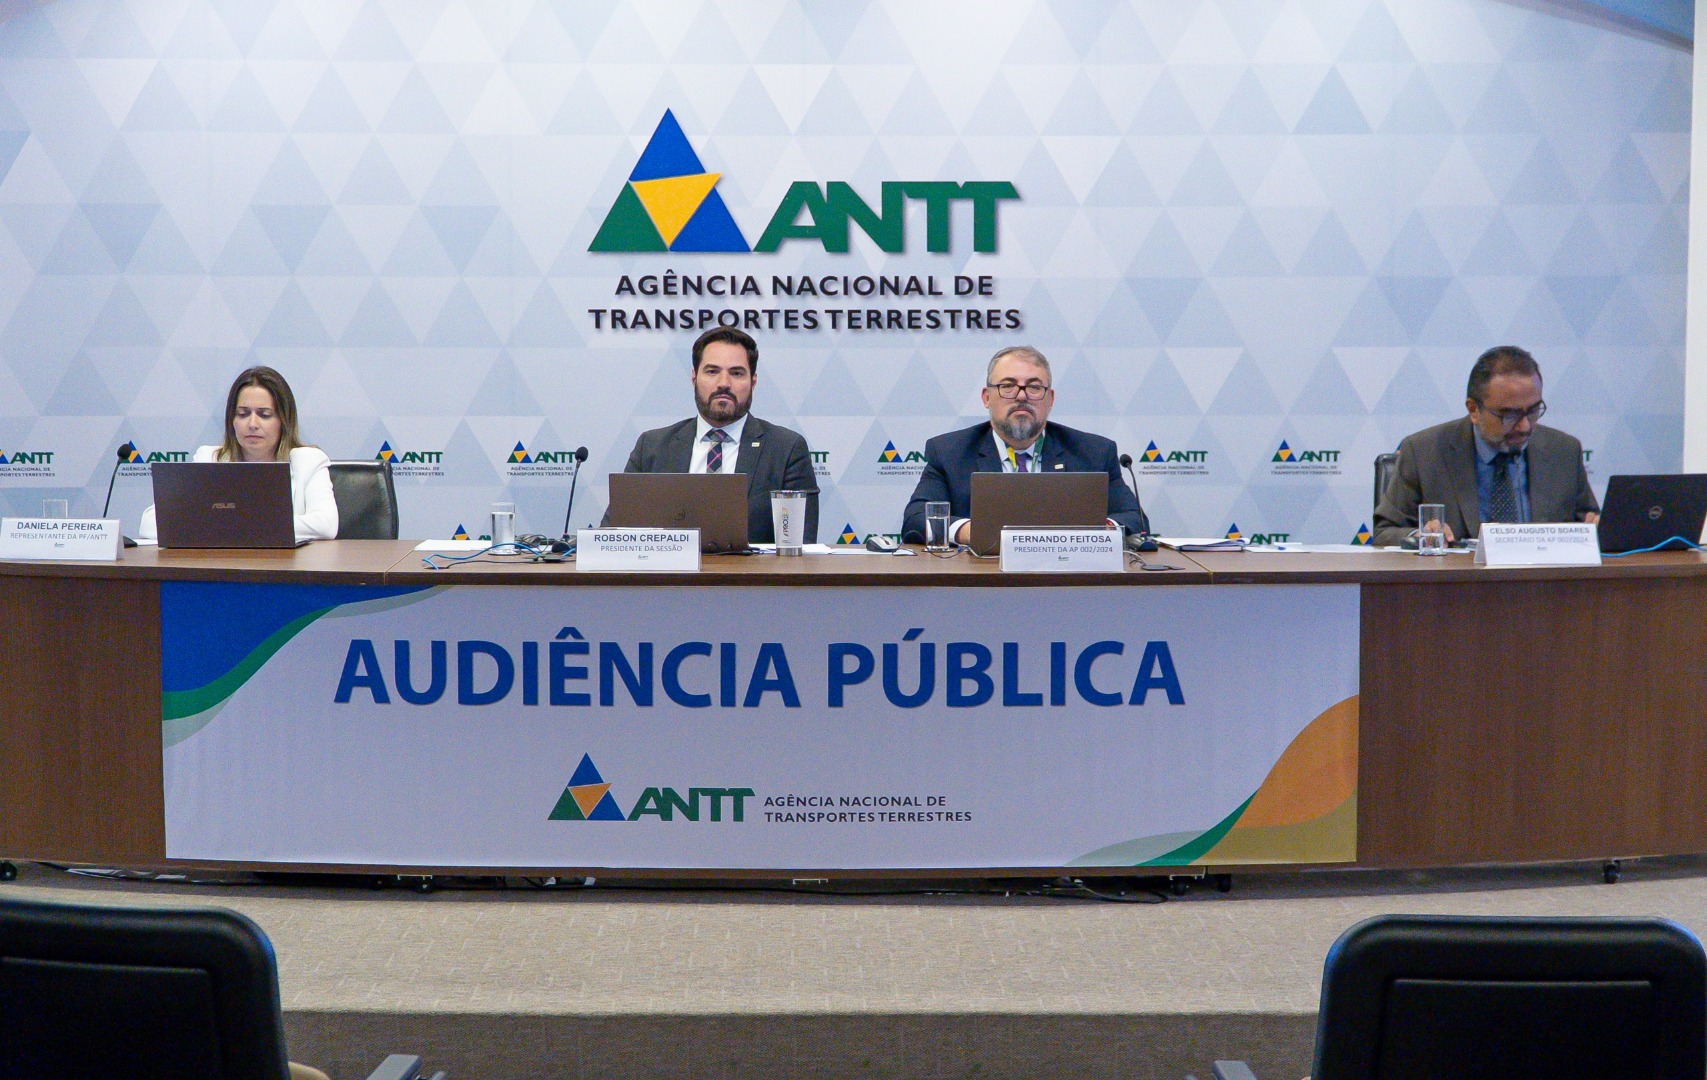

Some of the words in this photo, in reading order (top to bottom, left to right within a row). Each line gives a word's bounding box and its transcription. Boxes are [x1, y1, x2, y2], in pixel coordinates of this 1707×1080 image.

[752, 181, 1021, 253] ANTT
[615, 268, 761, 296] AGÊNCIA
[772, 275, 943, 296] NACIONAL
[954, 275, 993, 296] DE
[588, 309, 819, 330] TRANSPORTES
[825, 309, 1021, 330] TERRESTRES
[10, 452, 54, 464] ANTT
[146, 452, 189, 463] ANTT
[401, 451, 443, 463] ANTT
[534, 451, 576, 463] ANTT
[1166, 451, 1208, 462] ANTT
[1299, 450, 1341, 462] ANTT
[17, 521, 59, 530] DANIELA
[61, 522, 103, 531] PEREIRA
[1489, 527, 1517, 535] CELSO
[10, 532, 65, 540] REPRESENTANTE
[79, 533, 108, 541] PF/ANTT
[594, 534, 637, 542] ROBSON
[639, 534, 689, 542] CREPALDI
[1012, 535, 1067, 543] FERNANDO
[1070, 535, 1112, 543] FEITOSA
[1250, 533, 1290, 545] ANTT
[657, 544, 682, 552] SESSÃO
[333, 626, 802, 709] AUDIÊNCIA
[827, 627, 1186, 709] PÚBLICA
[626, 786, 756, 822] ANTT
[764, 793, 834, 807] AGÊNCIA
[839, 796, 922, 807] NACIONAL
[927, 796, 946, 807] DE
[764, 812, 875, 823] TRANSPORTES
[877, 811, 972, 822] TERRESTRES
